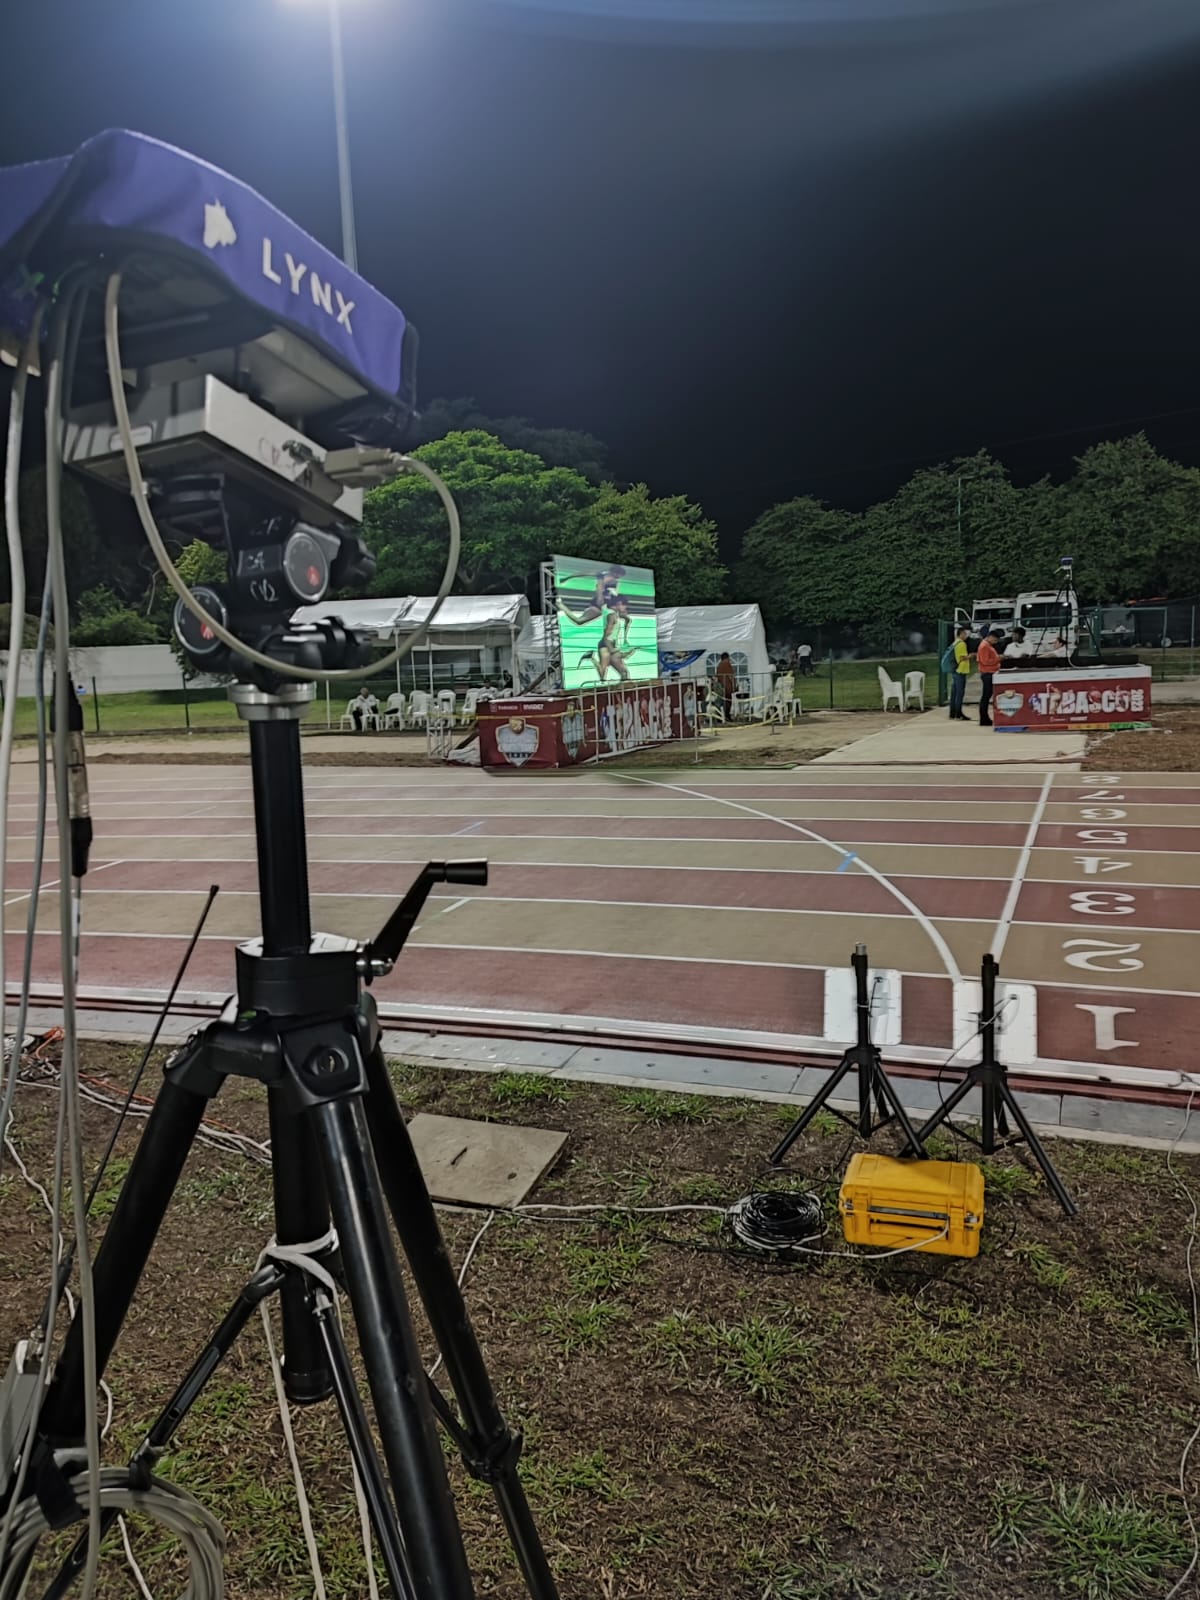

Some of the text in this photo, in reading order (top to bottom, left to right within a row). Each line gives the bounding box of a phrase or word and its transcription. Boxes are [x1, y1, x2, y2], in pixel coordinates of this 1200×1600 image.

[263, 237, 355, 335] LYNX
[1077, 790, 1125, 800] 7
[1080, 808, 1127, 820] 6
[1075, 829, 1129, 845] 5
[1072, 856, 1133, 874] 4
[1069, 891, 1136, 916] 3
[1061, 938, 1145, 972] 2
[1074, 1003, 1140, 1051] 1
